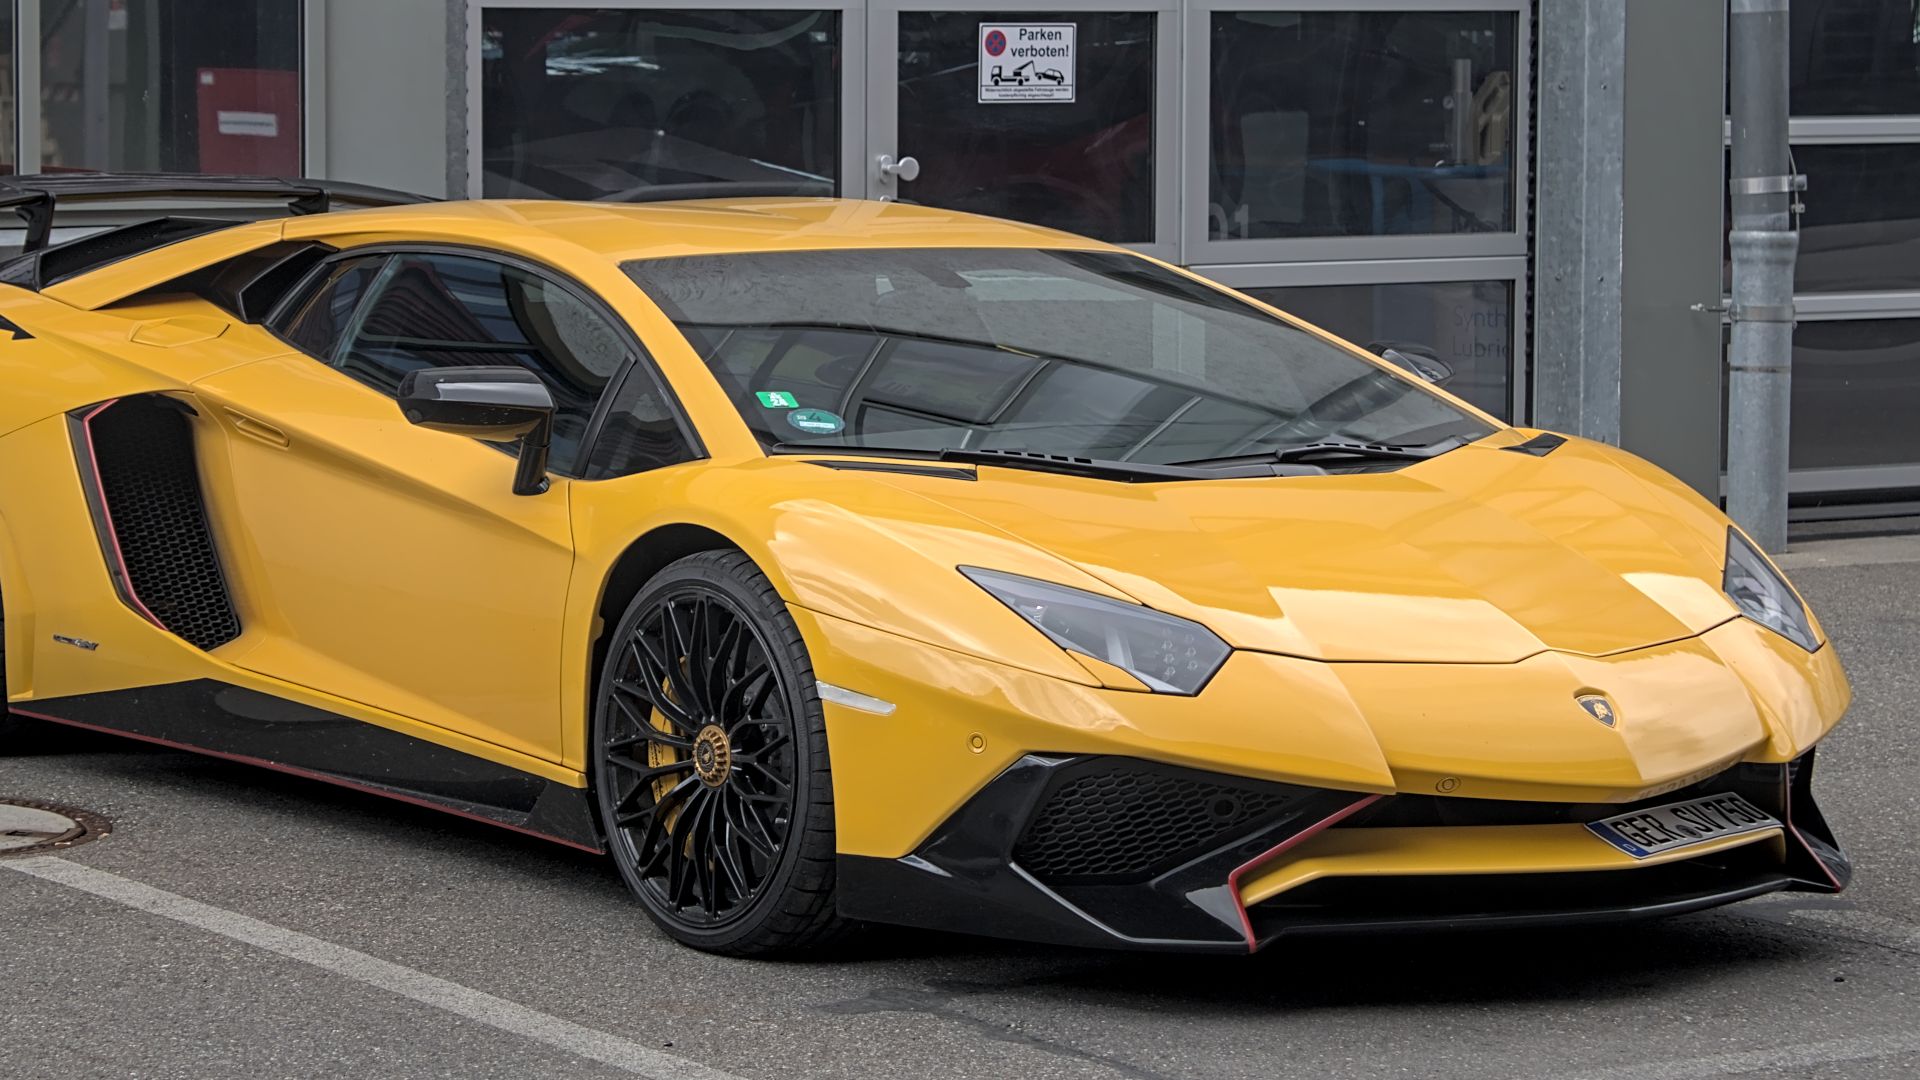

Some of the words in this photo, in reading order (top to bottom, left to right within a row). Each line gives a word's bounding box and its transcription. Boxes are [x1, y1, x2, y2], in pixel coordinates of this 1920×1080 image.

[1019, 28, 1062, 41] Parken
[1010, 44, 1069, 57] verboten!
[1610, 813, 1686, 847] GER
